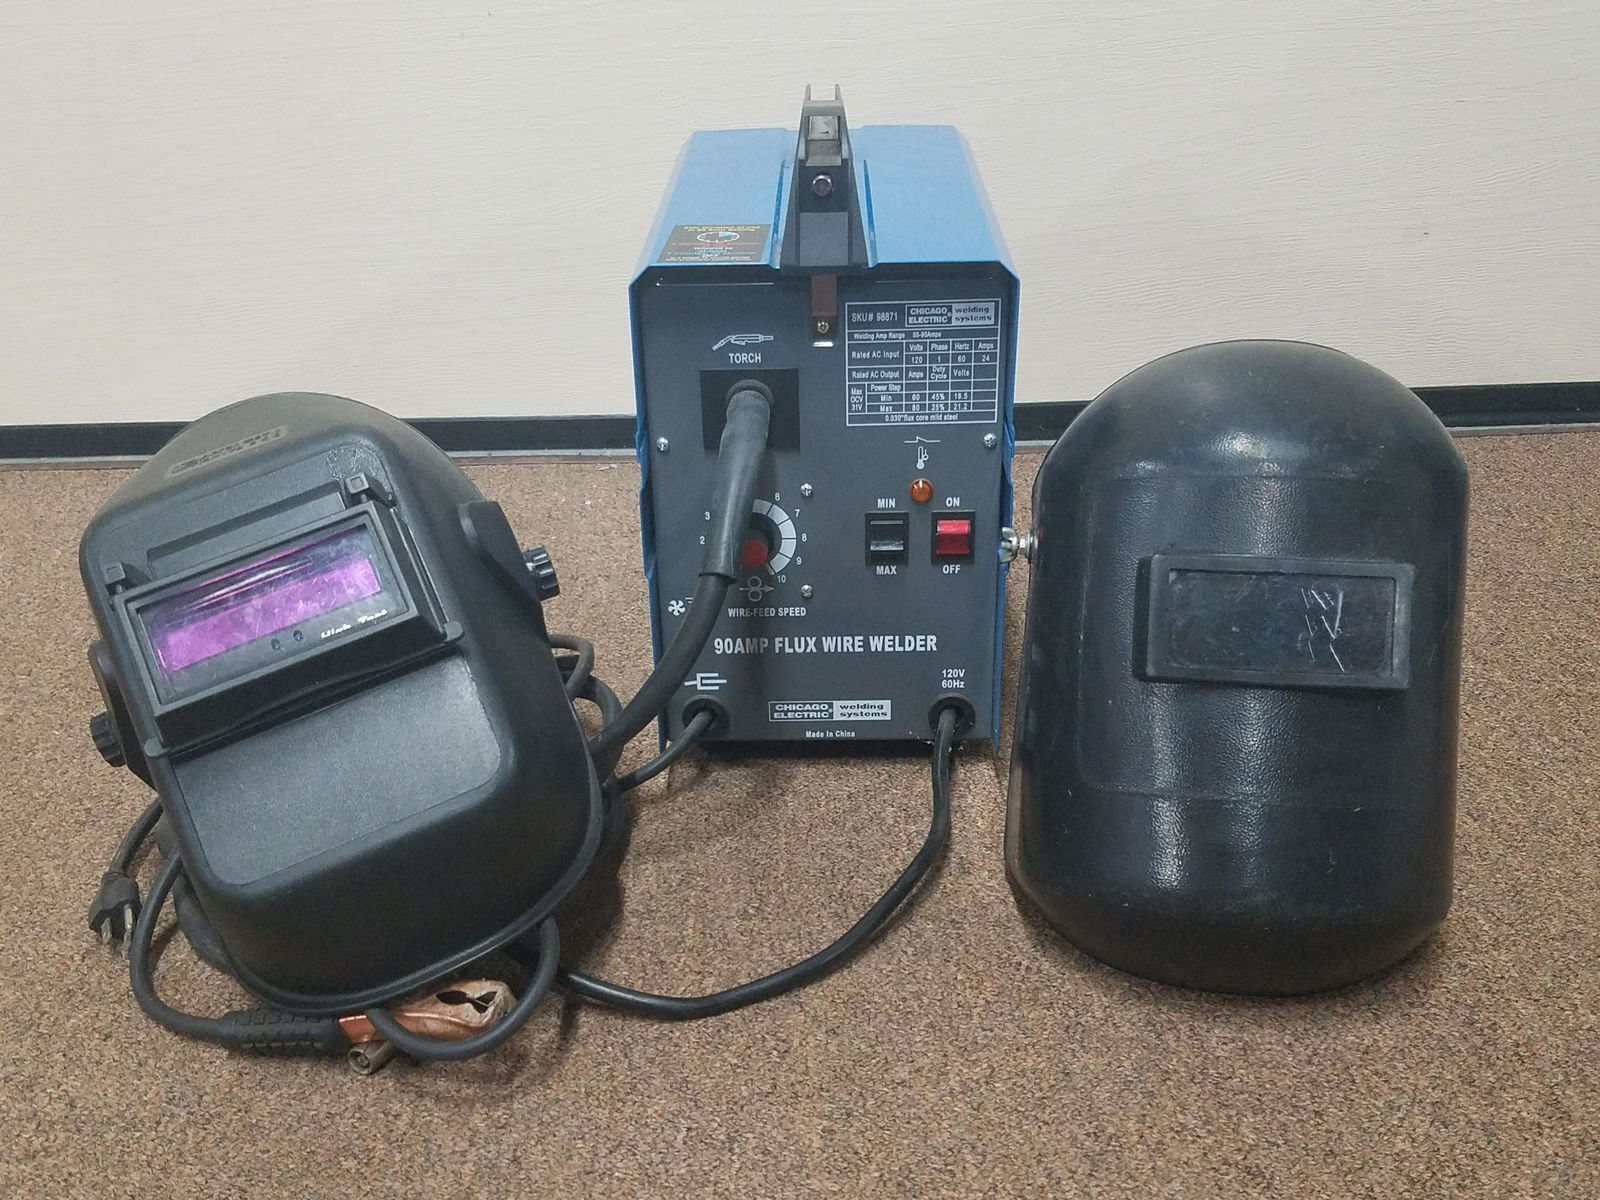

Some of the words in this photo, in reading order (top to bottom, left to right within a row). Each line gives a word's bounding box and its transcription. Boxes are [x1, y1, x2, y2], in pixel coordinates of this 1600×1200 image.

[910, 307, 947, 315] CHICAGO
[954, 306, 989, 314] welding
[851, 312, 873, 322] SKU#
[876, 312, 898, 321] 98871
[908, 316, 947, 324] ELECTRIC
[954, 315, 992, 323] systems
[853, 332, 875, 341] Welding
[875, 332, 888, 340] Amp
[888, 331, 905, 340] Range
[909, 343, 924, 352] Volts
[930, 342, 948, 351] Phase
[954, 342, 970, 350] Hertz
[978, 342, 994, 350] Amps
[728, 352, 762, 364] TORCH
[851, 350, 870, 359] Rated
[871, 350, 881, 359] AC
[883, 350, 900, 359] Input
[957, 354, 966, 363] 60
[981, 354, 990, 363] 24
[911, 356, 923, 364] 120
[851, 371, 869, 379] Rated
[870, 370, 881, 379] AC
[880, 369, 900, 379] Output
[908, 370, 924, 379] Amps
[932, 366, 946, 374] Duty
[953, 368, 970, 377] Volts
[930, 372, 947, 380] Cycle
[870, 384, 888, 392] Power
[888, 384, 901, 392] Step
[880, 394, 892, 402] Min
[911, 393, 920, 401] 60
[931, 393, 946, 401] 45%
[851, 404, 863, 412] 31V
[880, 404, 893, 412] Max
[931, 403, 946, 411] 25%
[953, 403, 968, 411] 21.2
[929, 413, 943, 421] mild
[943, 412, 959, 421] steel
[877, 498, 896, 509] MIN
[945, 496, 960, 508] ON
[704, 511, 711, 521] 3
[794, 508, 801, 518] 7
[699, 535, 706, 545] 2
[801, 533, 808, 542] 8
[796, 556, 802, 566] 9
[876, 565, 897, 576] MAX
[942, 564, 961, 575] OFF
[777, 574, 787, 584] 10
[777, 606, 807, 617] SPEED
[713, 637, 769, 655] 90AMP
[774, 637, 818, 654] FLUX
[822, 636, 864, 652] WIRE
[869, 635, 938, 652] WELDER
[941, 668, 965, 678] 120V
[941, 679, 965, 689] 60Hz
[839, 703, 884, 711] welding
[773, 711, 830, 719] ELECTRIC
[839, 711, 888, 719] systems
[805, 730, 825, 738] Made
[835, 730, 855, 738] China
